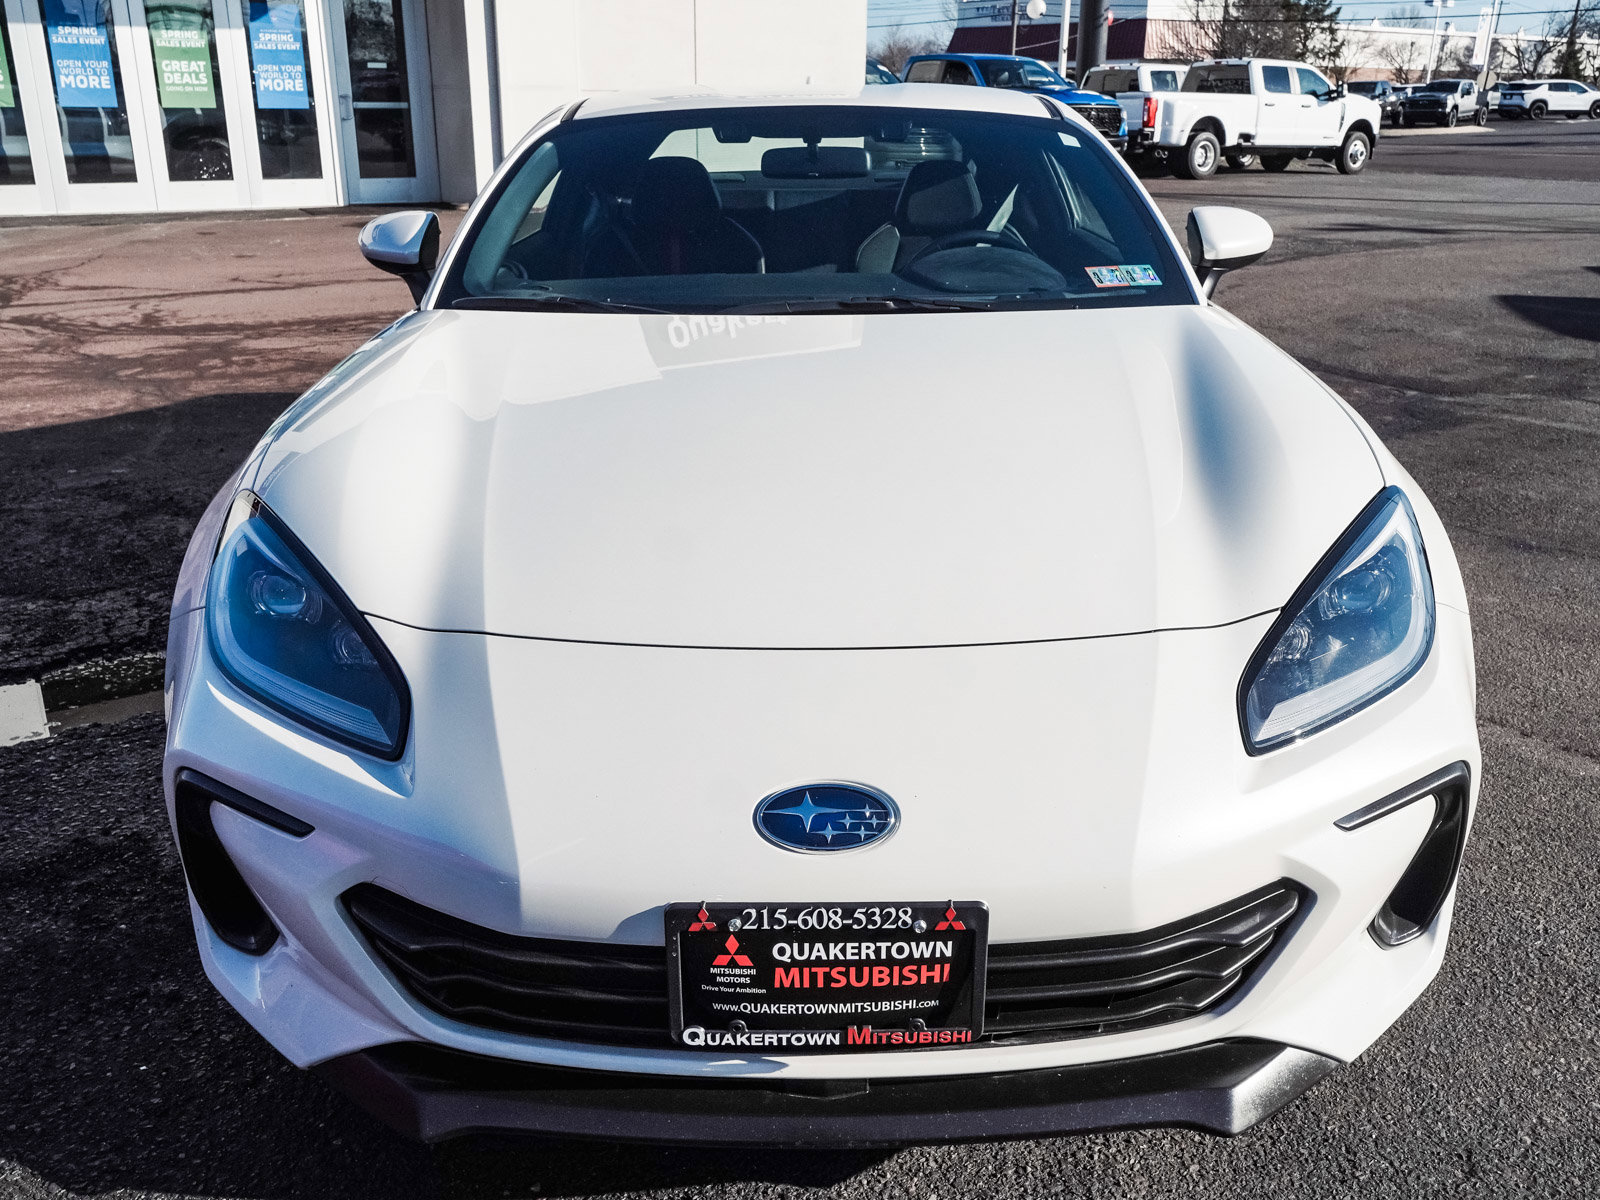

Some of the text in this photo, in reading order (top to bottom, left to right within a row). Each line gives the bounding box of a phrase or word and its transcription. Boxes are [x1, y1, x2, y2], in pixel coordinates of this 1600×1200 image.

[57, 26, 98, 35] SPRING
[160, 30, 199, 39] SPRING
[52, 36, 105, 45] SALES EVENT
[258, 33, 294, 42] SPRING
[155, 39, 206, 48] SALES EVENT
[253, 42, 300, 50] SALES EVENT
[56, 60, 109, 69] OPEN YOUR
[161, 60, 206, 72] GREAT
[257, 64, 303, 73] OPEN YOUR
[59, 67, 108, 76] WORLD TO
[259, 71, 302, 80] WORLD TO
[60, 75, 111, 89] MORE
[163, 72, 208, 85] DEALS
[259, 79, 304, 91] MORE
[742, 906, 913, 931] 215-608-5328
[772, 941, 953, 963] QUAKERTOWN
[710, 967, 757, 976] MITSUBISHI
[773, 963, 951, 988] MITSUBISHI
[716, 976, 751, 984] MOTORS
[701, 984, 767, 995] Drive Your Ambition
[682, 1025, 972, 1047] QUAKERTOWN MITSUBISHI
